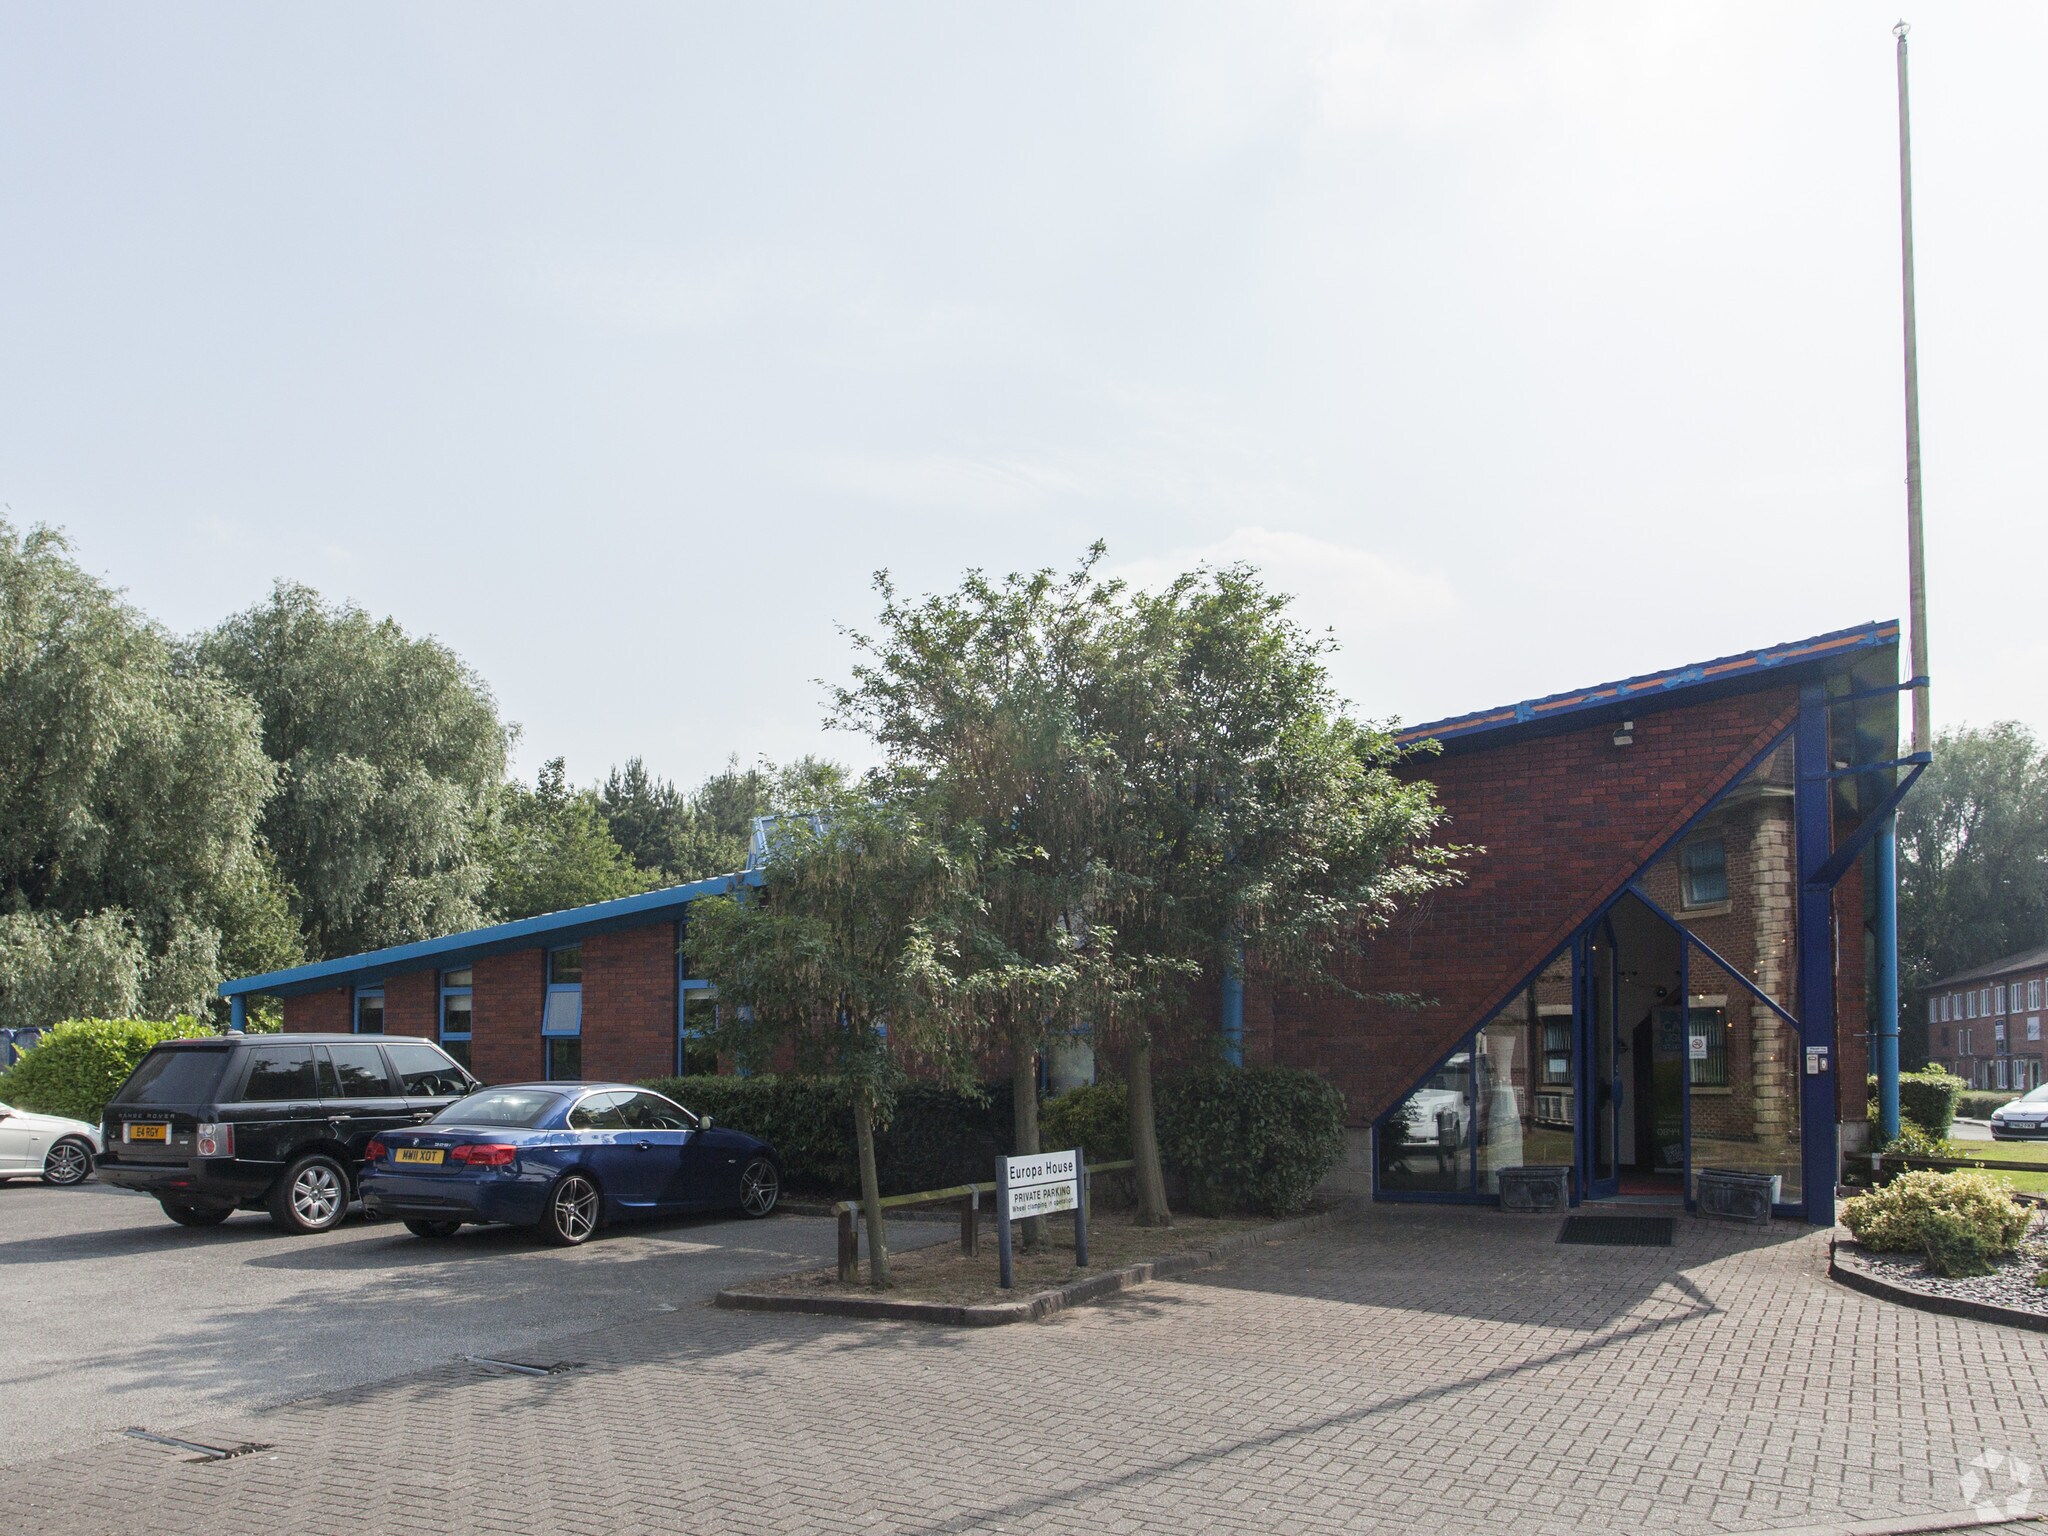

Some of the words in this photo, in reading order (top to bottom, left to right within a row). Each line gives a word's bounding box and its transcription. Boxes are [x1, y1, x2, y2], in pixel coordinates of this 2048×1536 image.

[136, 1127, 144, 1137] E4
[146, 1127, 159, 1137] RGY
[402, 1150, 418, 1160] MW11
[420, 1150, 437, 1161] XOT
[1010, 1166, 1042, 1179] Europa
[1045, 1161, 1073, 1175] House
[1014, 1190, 1041, 1203] PRIVATE
[1043, 1186, 1071, 1198] PARKING
[1027, 1202, 1047, 1210] clamping
[1053, 1198, 1073, 1206] operation
